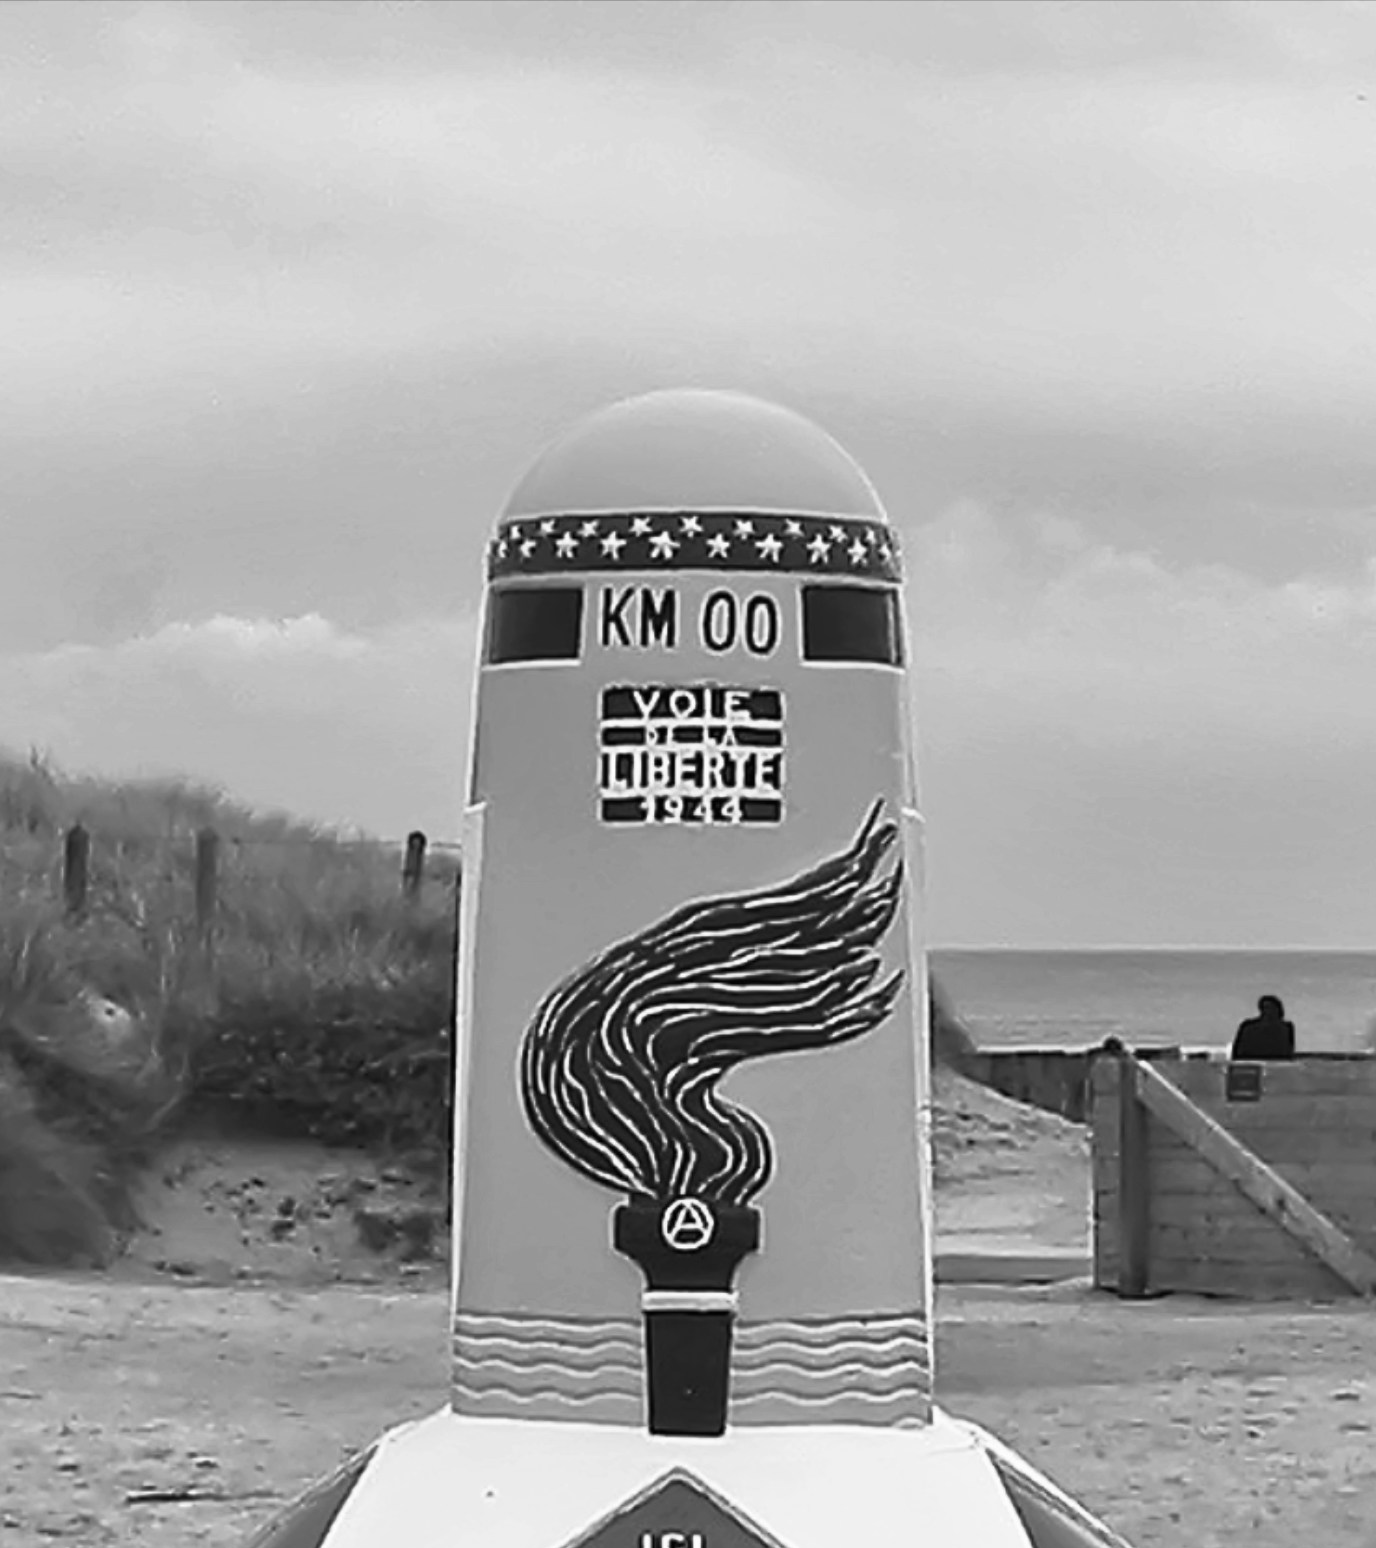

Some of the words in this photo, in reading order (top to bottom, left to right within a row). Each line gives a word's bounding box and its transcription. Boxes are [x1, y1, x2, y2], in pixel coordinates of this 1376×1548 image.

[601, 585, 678, 648] KM
[633, 688, 751, 720] VOIE
[607, 752, 776, 791] LIBERTE
[640, 795, 743, 824] 1944
